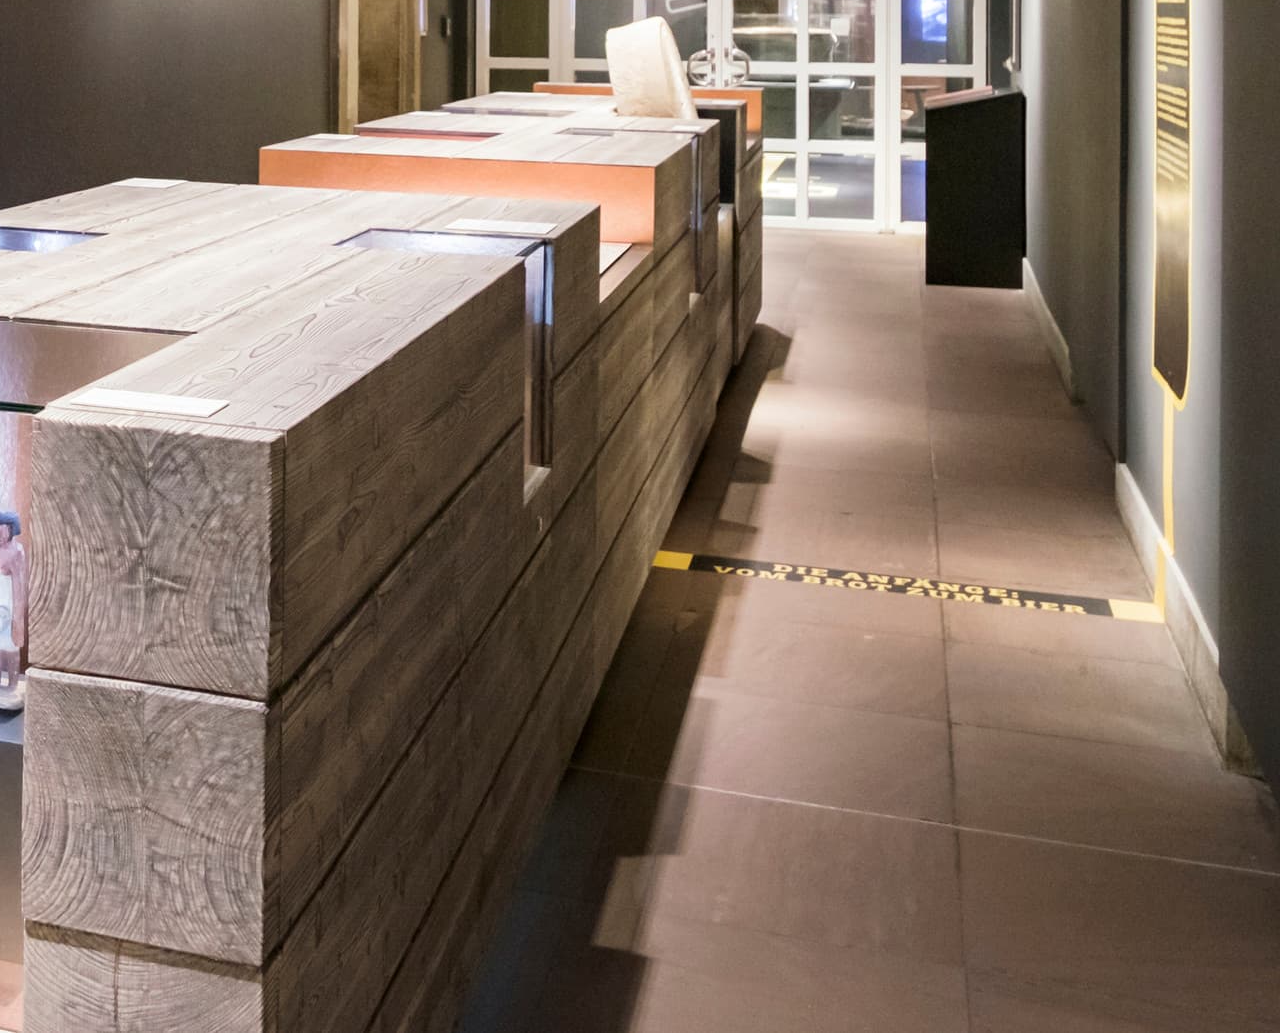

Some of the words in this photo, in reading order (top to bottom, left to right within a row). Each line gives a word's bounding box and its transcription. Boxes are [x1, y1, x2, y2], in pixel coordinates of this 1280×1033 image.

[773, 563, 829, 577] DIE
[713, 565, 787, 581] VOM
[803, 575, 892, 593] BROT
[906, 587, 985, 603] ZUM
[1001, 597, 1087, 615] BIER
